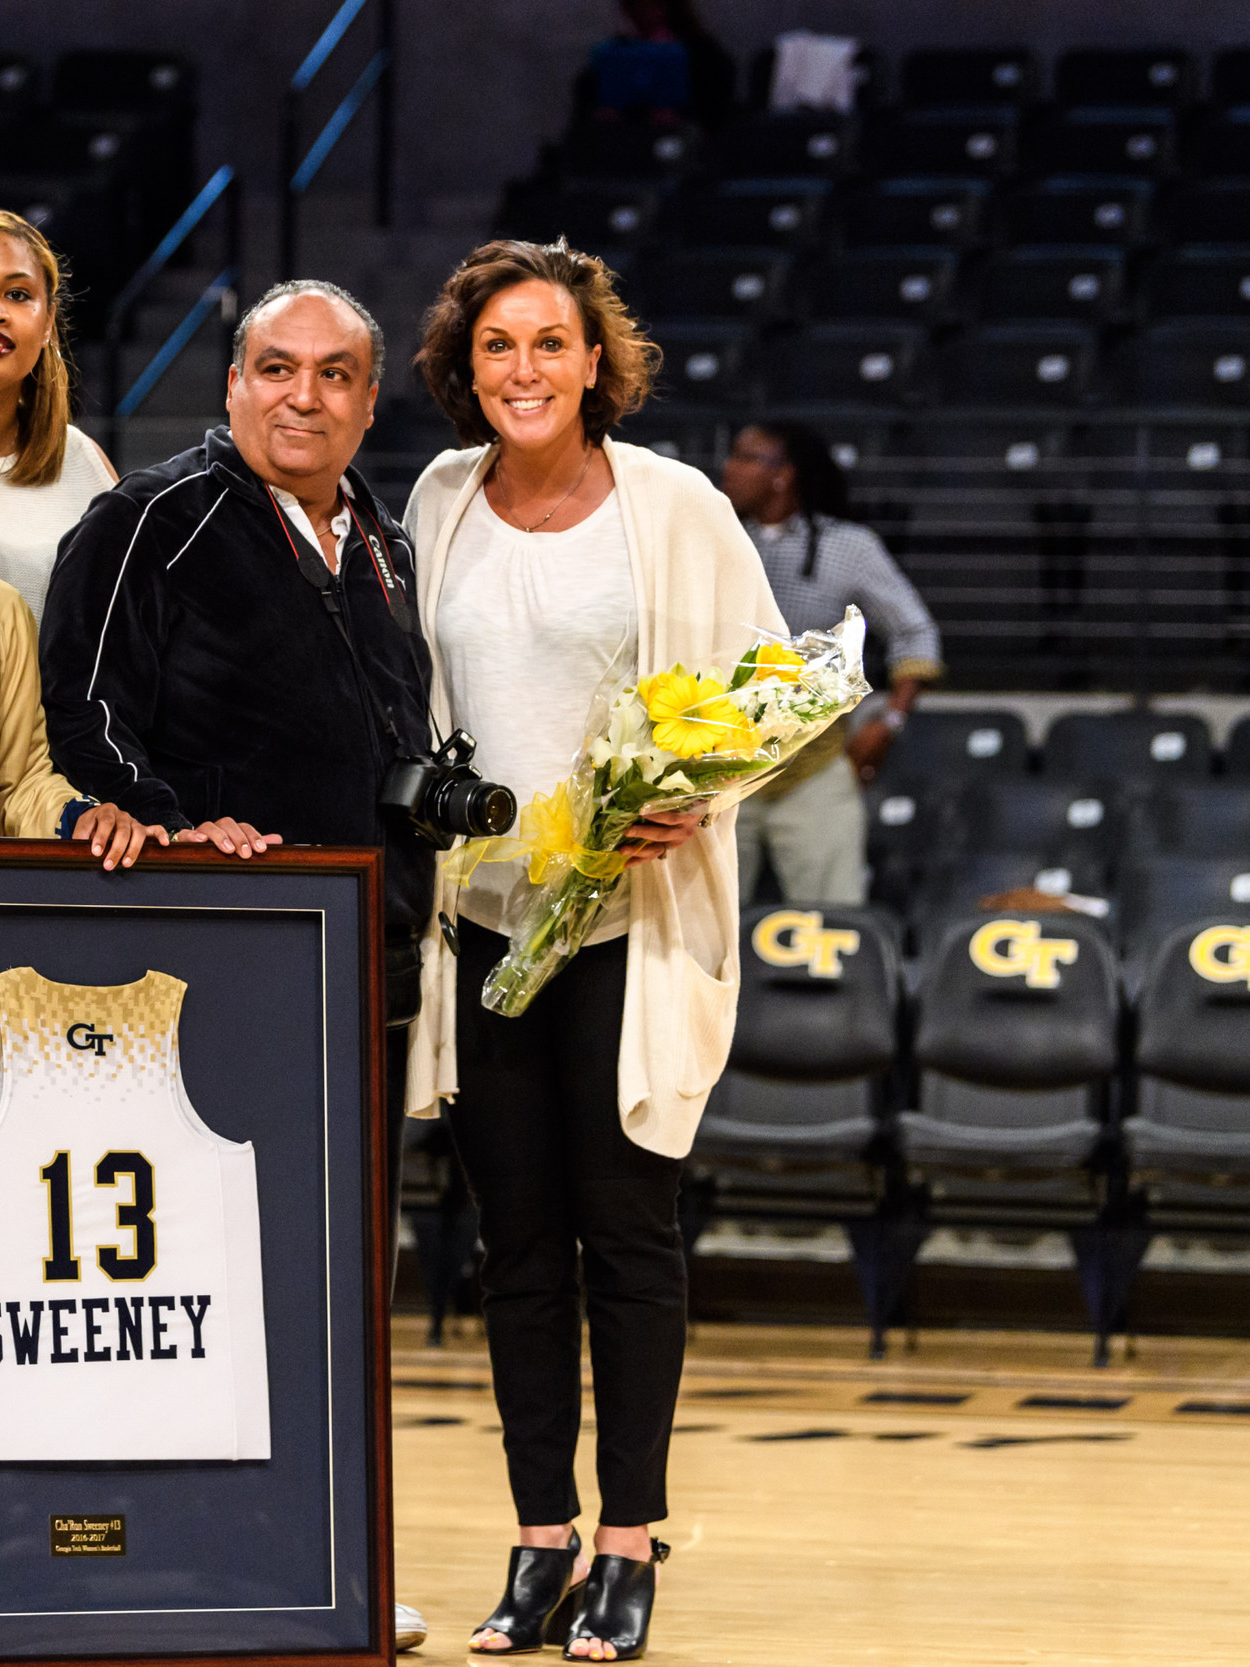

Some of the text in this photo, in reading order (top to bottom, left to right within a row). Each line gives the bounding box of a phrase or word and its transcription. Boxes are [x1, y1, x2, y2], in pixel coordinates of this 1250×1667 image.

[368, 534, 395, 589] Canon
[751, 910, 861, 979] GT
[969, 919, 1079, 989] GT
[1189, 924, 1250, 991] G
[66, 1022, 114, 1056] GT
[39, 1149, 159, 1283] 13
[55, 1545, 72, 1553] Georgia
[70, 1534, 106, 1542] 2016-2017
[83, 1519, 110, 1533] Sweeney
[110, 1519, 121, 1531] #13
